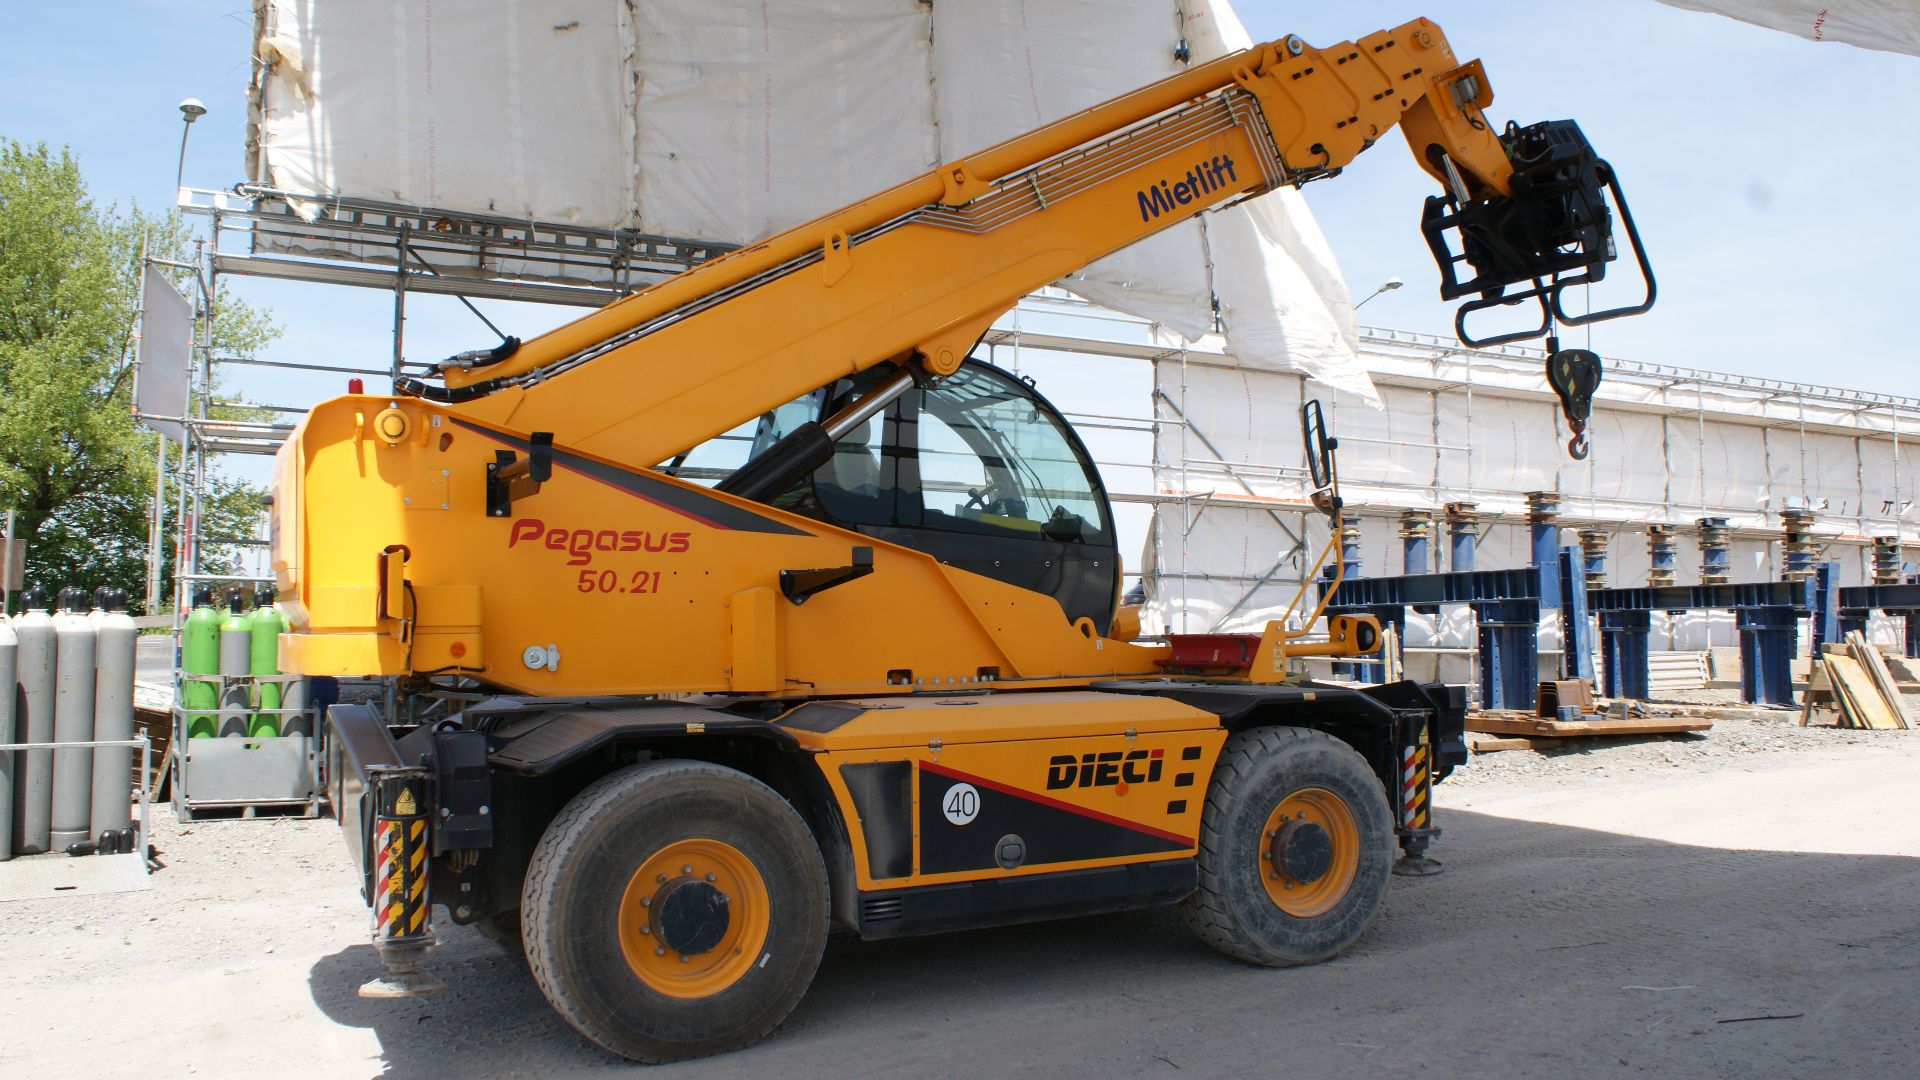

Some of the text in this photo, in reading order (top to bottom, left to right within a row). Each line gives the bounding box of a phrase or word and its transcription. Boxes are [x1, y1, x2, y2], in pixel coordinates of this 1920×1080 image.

[1137, 154, 1237, 222] Mietlift
[508, 518, 692, 566] Pegasus
[577, 569, 661, 594] 50.21
[1046, 749, 1165, 790] DIECI
[947, 790, 976, 818] 40
